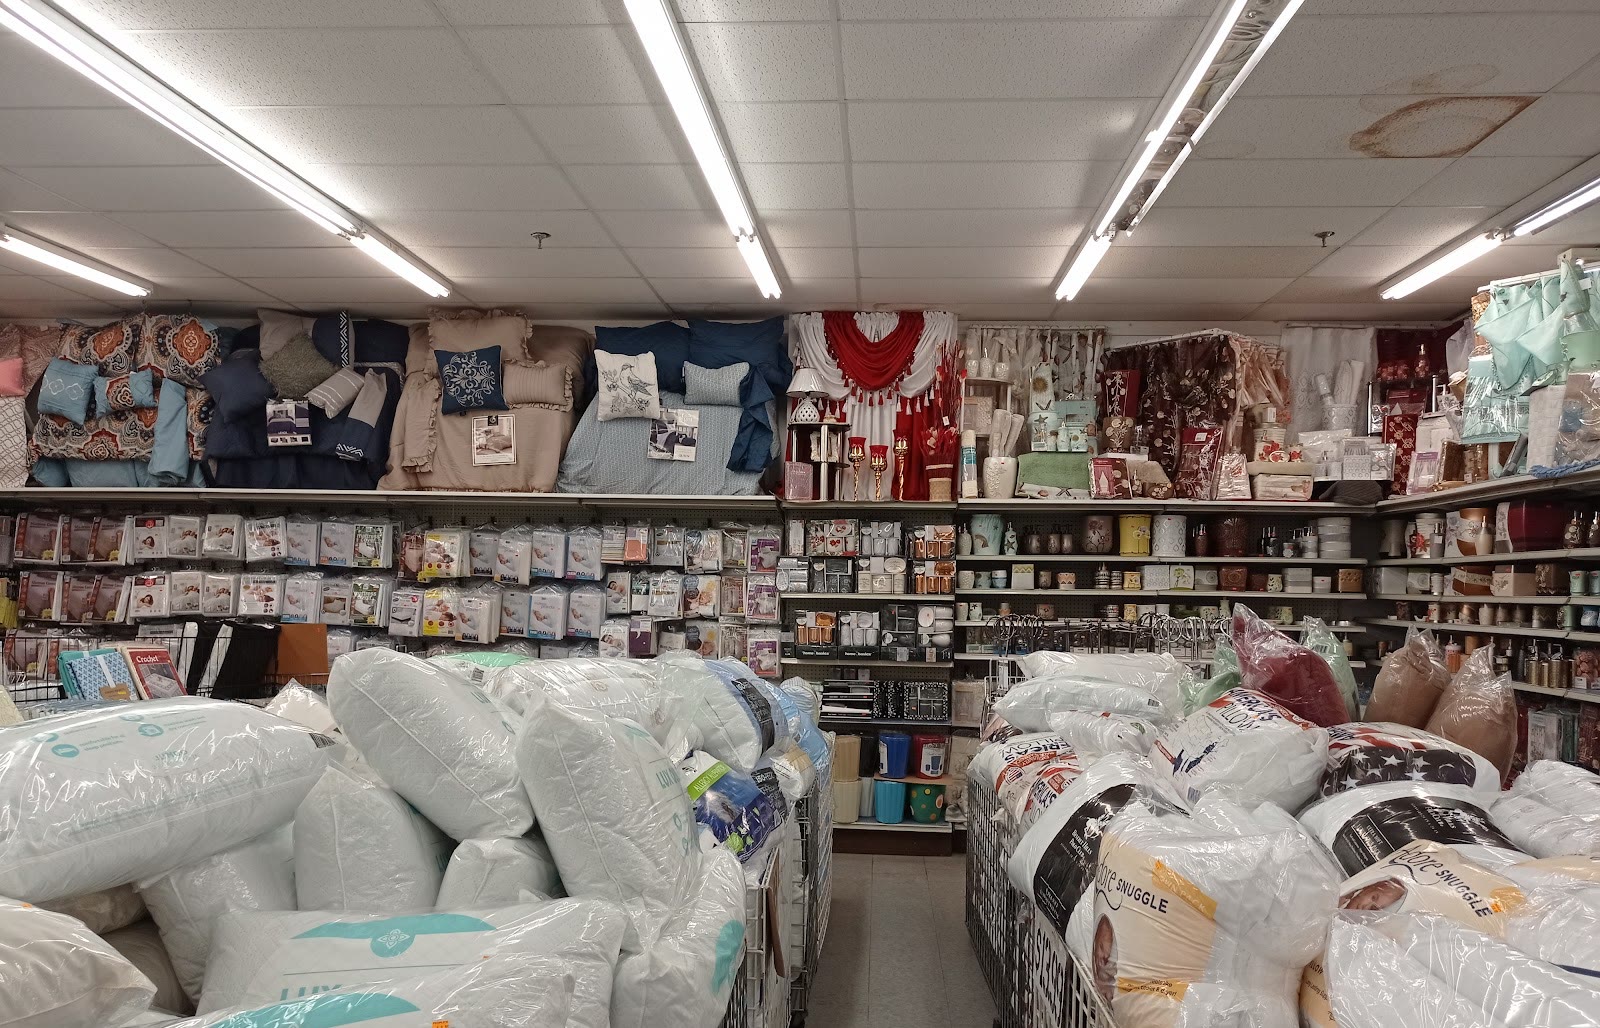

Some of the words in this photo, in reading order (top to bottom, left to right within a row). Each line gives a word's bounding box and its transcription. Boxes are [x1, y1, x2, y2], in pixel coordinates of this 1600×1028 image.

[135, 655, 160, 664] Crochet
[1097, 852, 1117, 893] dore
[1116, 878, 1169, 914] SNUGGLE
[1435, 869, 1493, 918] SNUGGLE
[1181, 891, 1208, 912] PACK
